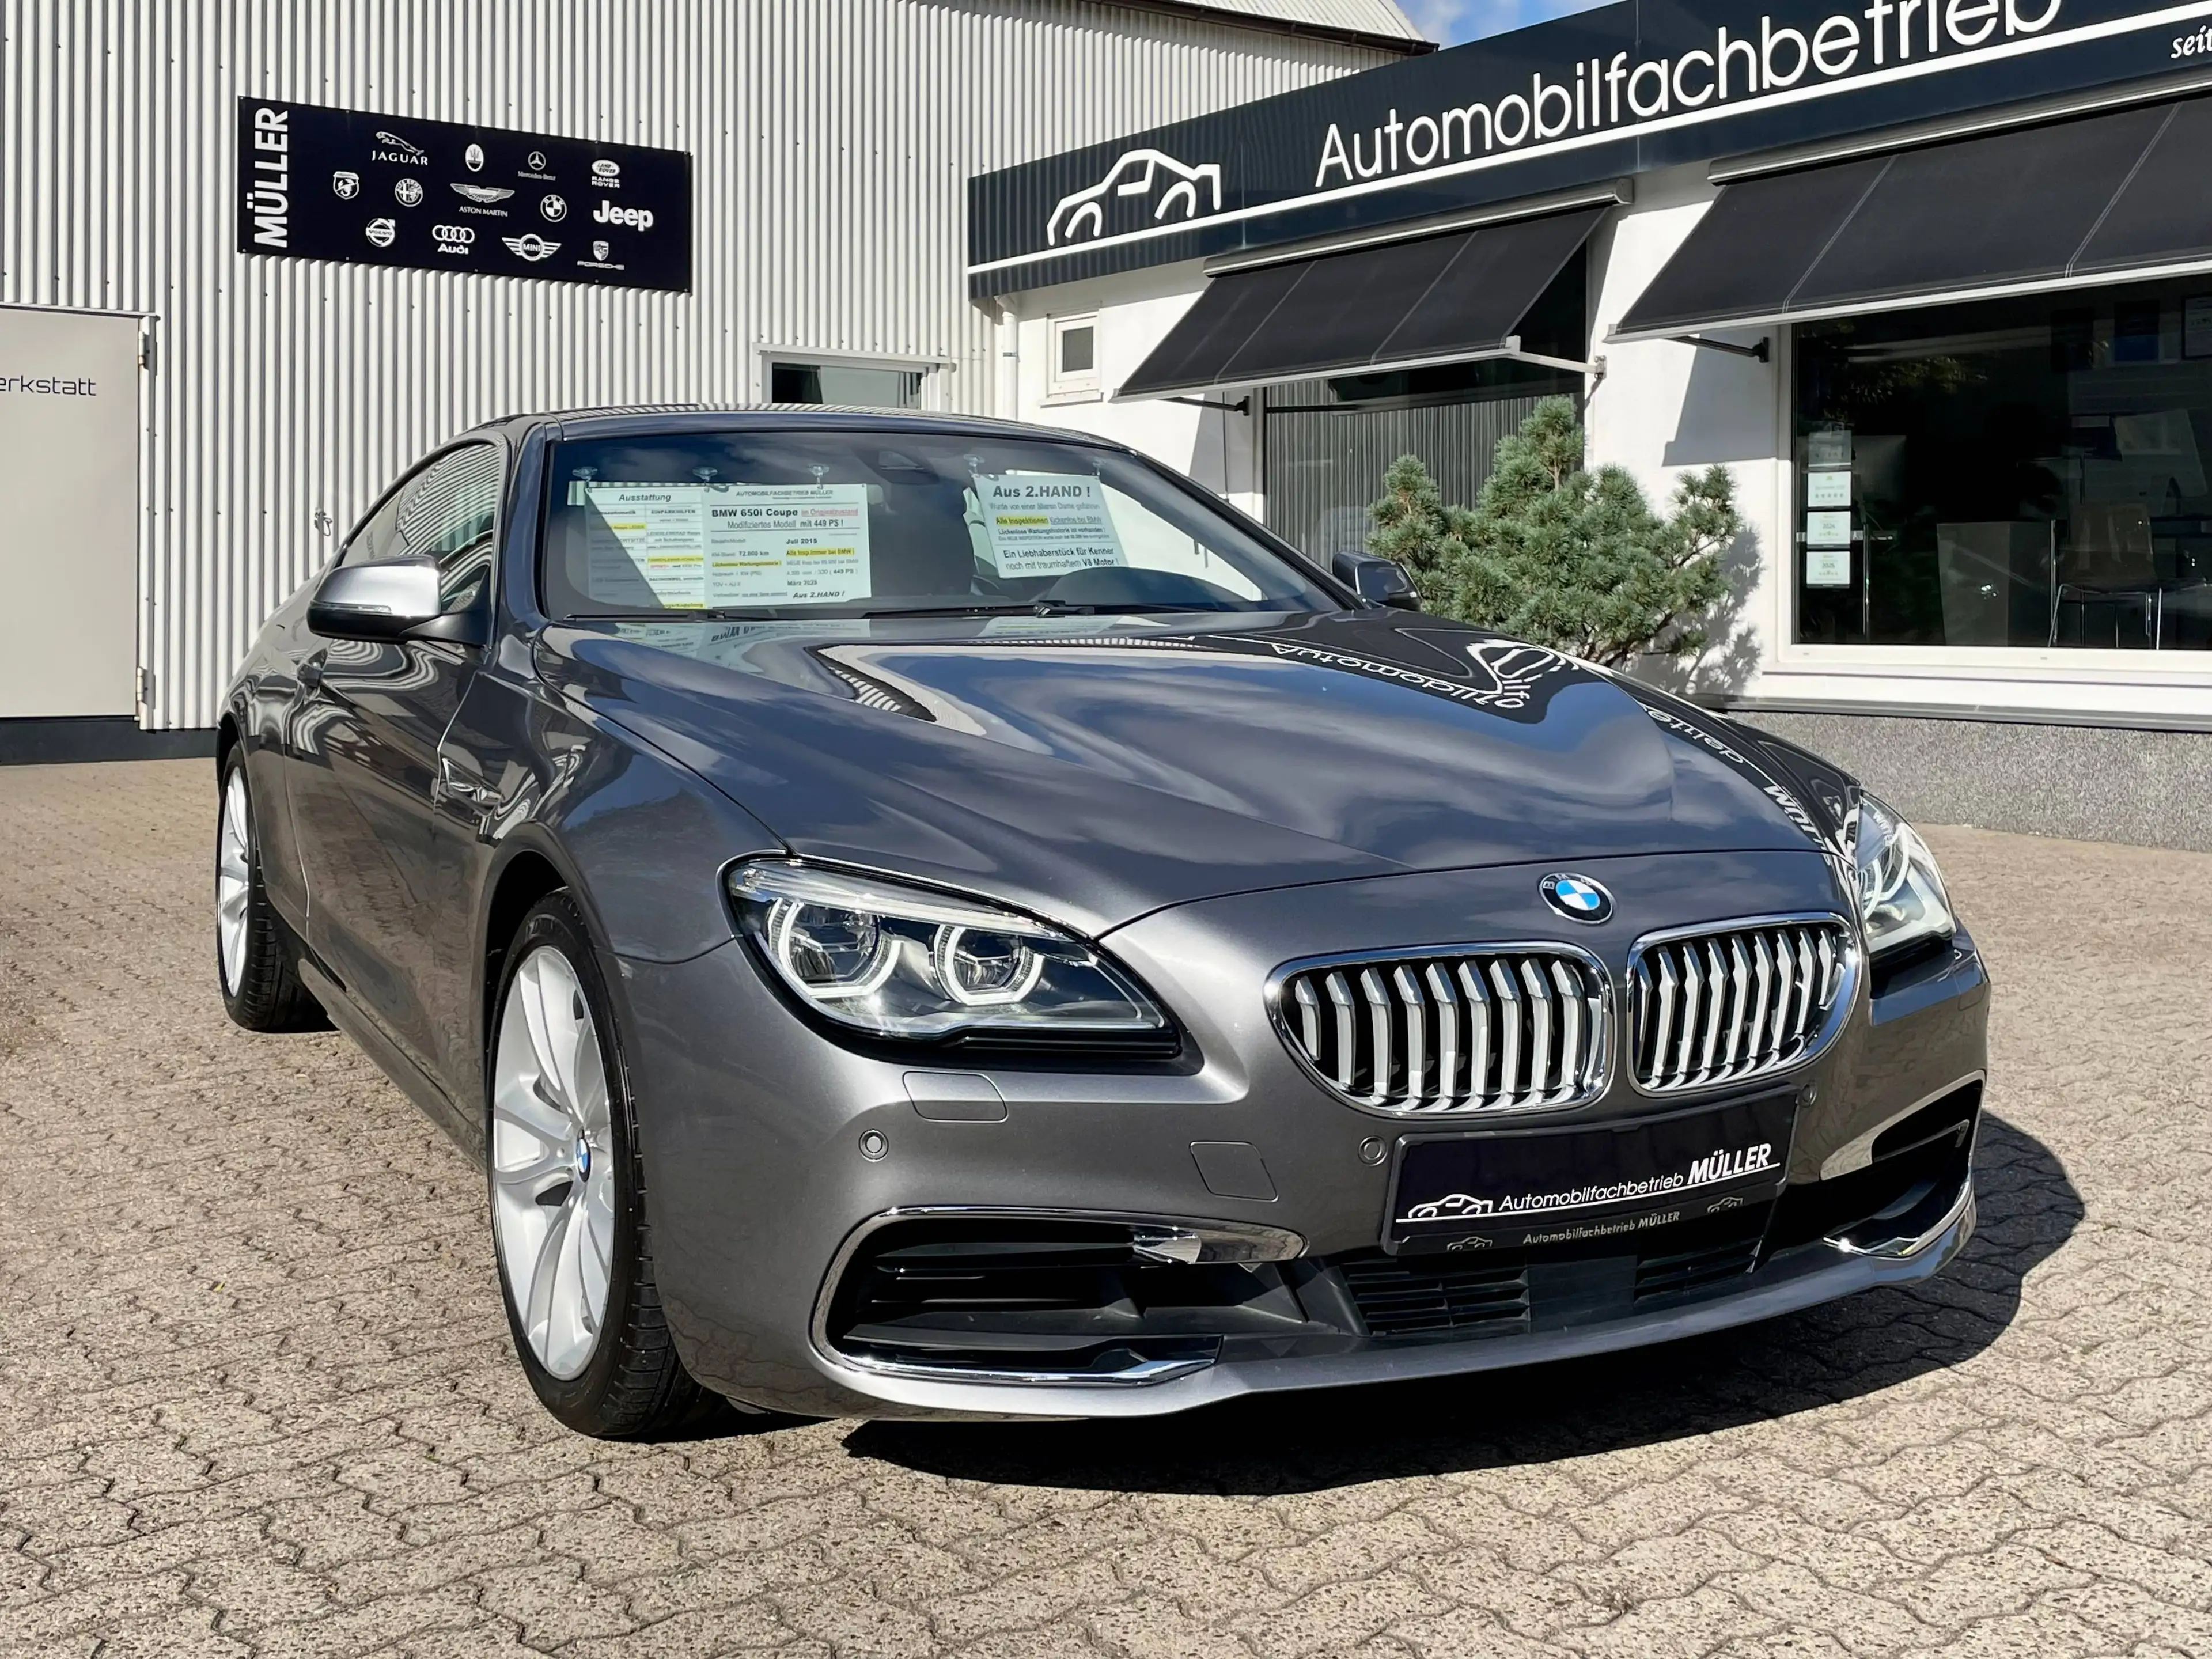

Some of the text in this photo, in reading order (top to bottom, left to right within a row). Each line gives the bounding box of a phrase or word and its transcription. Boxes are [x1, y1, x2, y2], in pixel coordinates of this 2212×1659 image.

[2171, 25, 2212, 58] seit
[1315, 0, 2061, 187] Automobilfachbetrieb
[372, 150, 428, 165] JAGUAR
[246, 107, 288, 248] MÜLLER
[459, 206, 508, 217] ASTON MARTIN
[593, 200, 654, 232] Jeep
[437, 243, 469, 255] Audi
[523, 243, 541, 252] MINI
[993, 486, 1020, 498] Aus
[1025, 486, 1082, 498] 2.HAND
[711, 509, 737, 517] BMW
[740, 509, 763, 517] 650i
[728, 520, 771, 529] Modifiziertes
[773, 520, 796, 528] Modell
[800, 519, 812, 528] mit
[1008, 517, 1049, 525] Inspektionen
[1003, 547, 1113, 558] Ein Liebhaberstück für Kenner
[1006, 562, 1023, 570] noch
[1093, 558, 1115, 566] Motor
[1498, 1142, 1772, 1211] Automobilfachbetrieb MÜLLER
[1522, 1211, 1679, 1244] Automobilfachbetrieb MÜLLER
